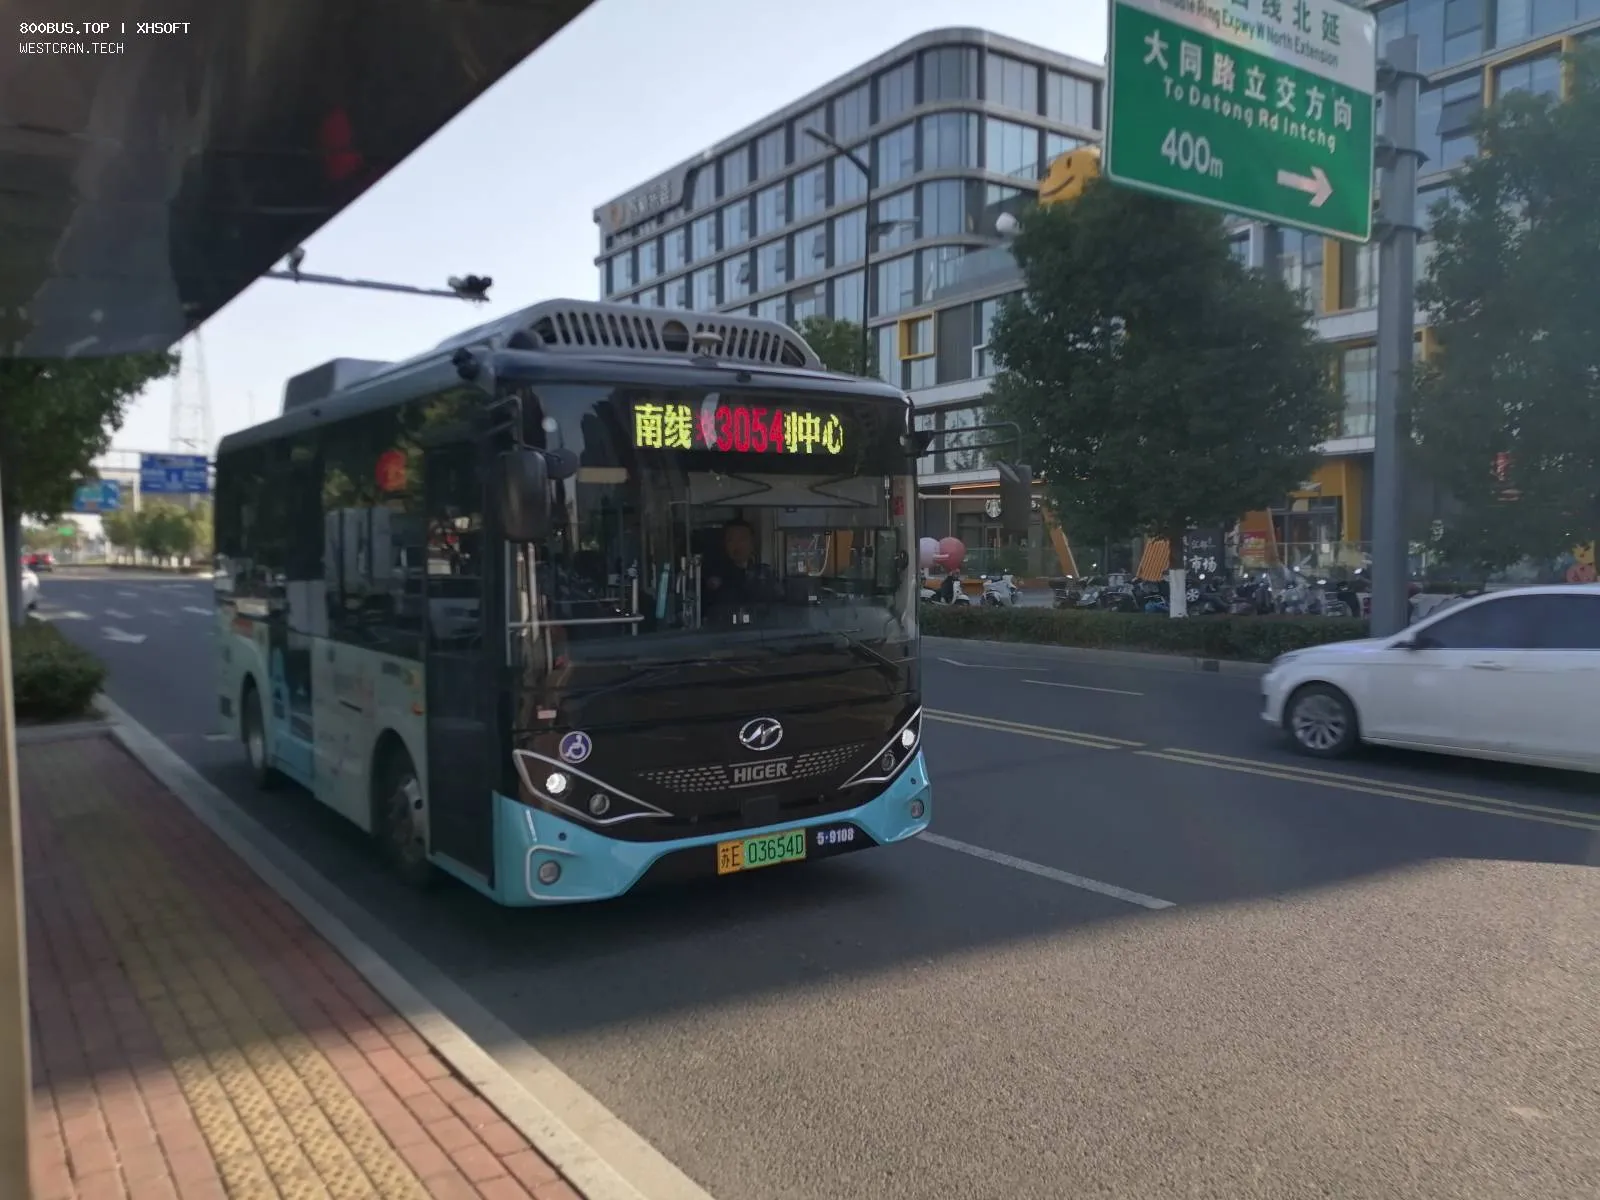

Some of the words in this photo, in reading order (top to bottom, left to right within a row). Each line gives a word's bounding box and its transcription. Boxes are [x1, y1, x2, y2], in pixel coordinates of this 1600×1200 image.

[1294, 35, 1339, 68] Extension
[1143, 29, 1352, 132] 大同路立交方向
[1163, 76, 1184, 101] To
[1189, 87, 1252, 128] Datong
[1258, 108, 1279, 131] Rd
[1283, 116, 1337, 154] Intchg
[734, 762, 789, 783] HIGER
